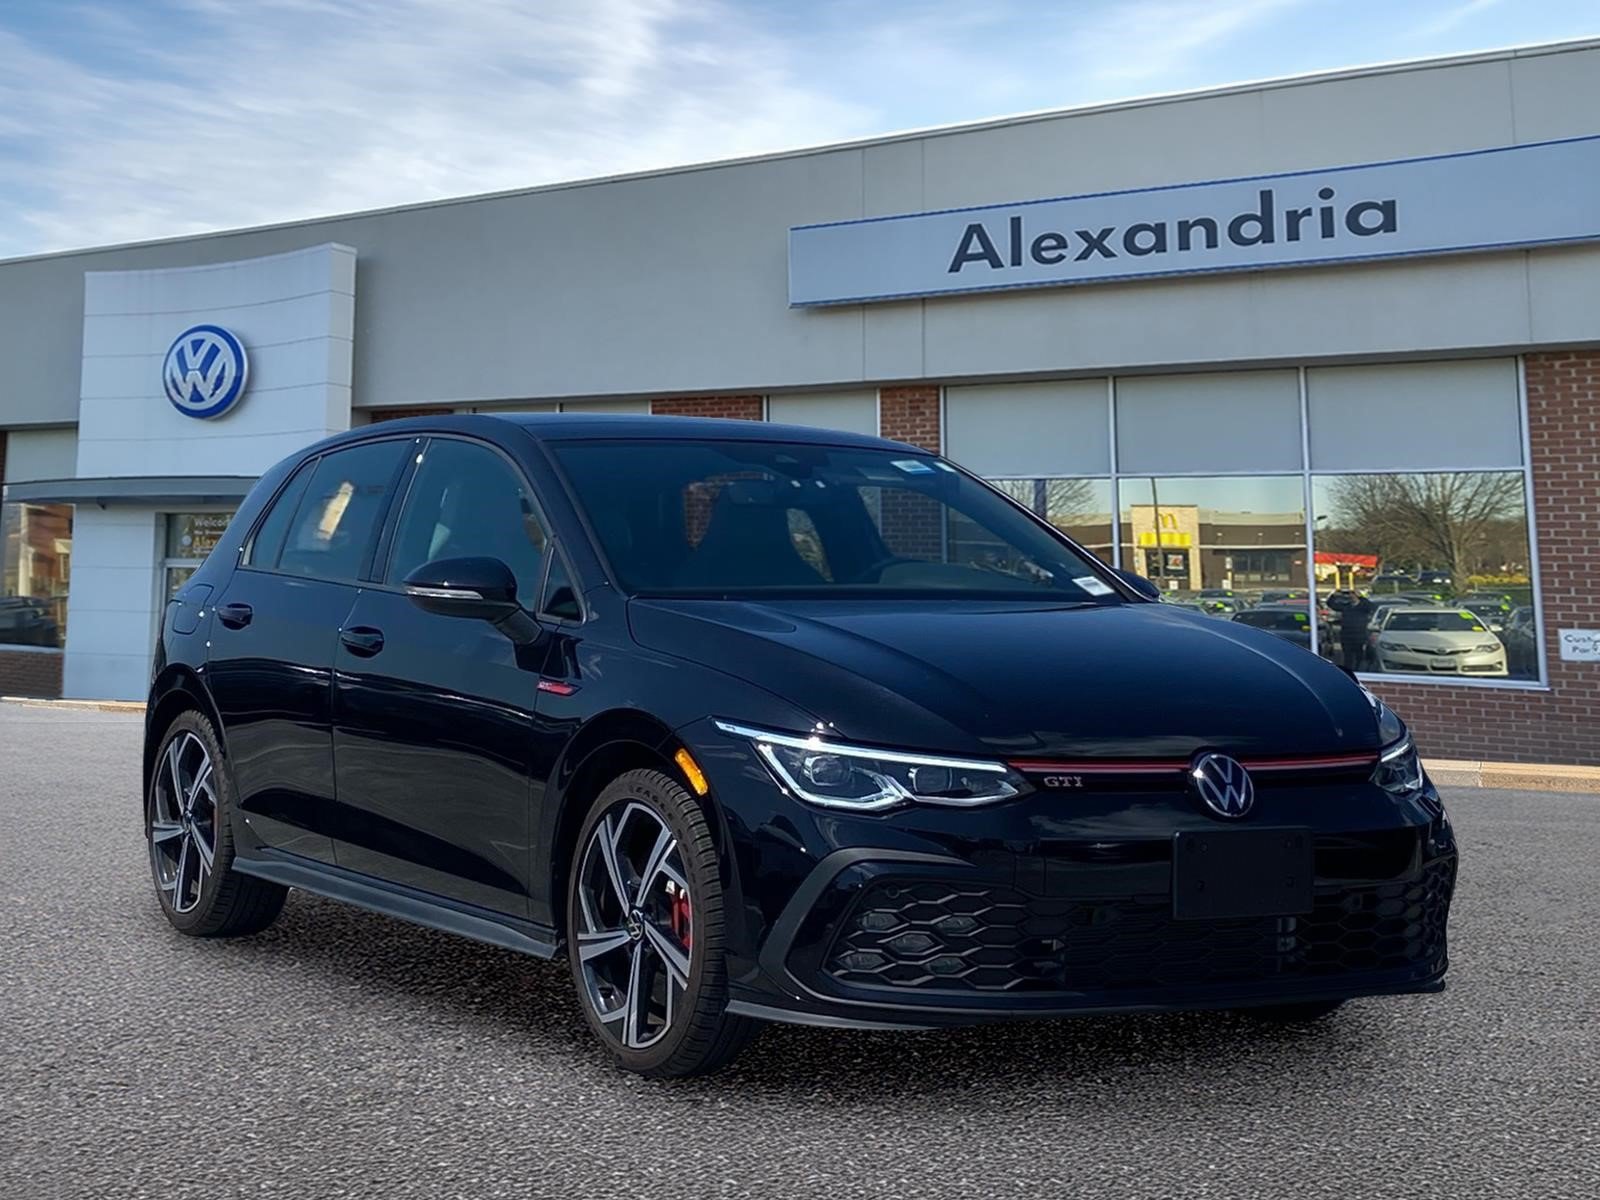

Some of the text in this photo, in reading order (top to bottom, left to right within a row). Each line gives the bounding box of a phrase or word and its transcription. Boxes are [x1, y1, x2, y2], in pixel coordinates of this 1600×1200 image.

[947, 187, 1398, 274] Alexandria
[164, 328, 240, 413] VW
[1044, 776, 1083, 787] GTI
[1198, 755, 1253, 815] VW
